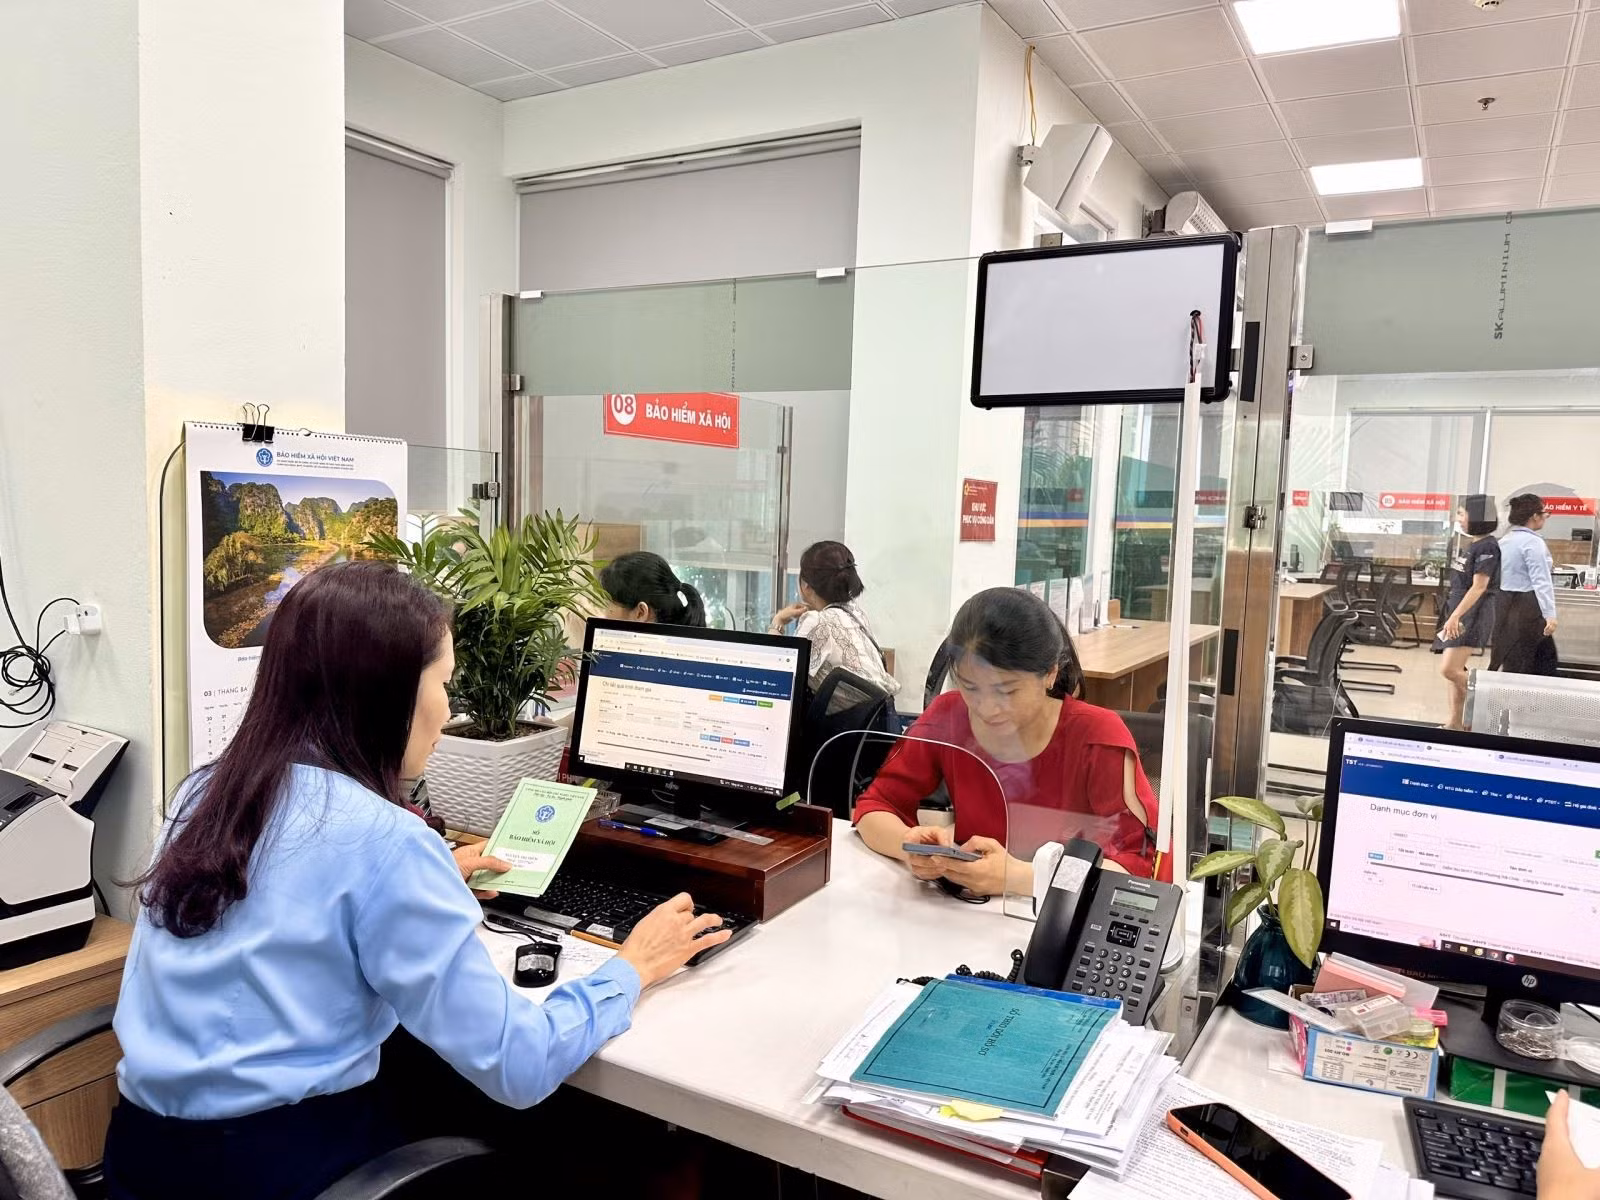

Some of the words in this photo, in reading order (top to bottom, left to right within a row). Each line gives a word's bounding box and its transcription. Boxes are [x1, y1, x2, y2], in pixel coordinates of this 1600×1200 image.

[614, 394, 634, 414] 08
[646, 398, 668, 420] BẢO
[671, 401, 696, 424] HIỂM
[698, 410, 712, 427] XÃ
[714, 412, 731, 433] HỘI
[1370, 804, 1391, 813] Danh
[1412, 810, 1428, 818] đơn
[1128, 880, 1150, 888] Panasonic
[1524, 976, 1535, 986] hp
